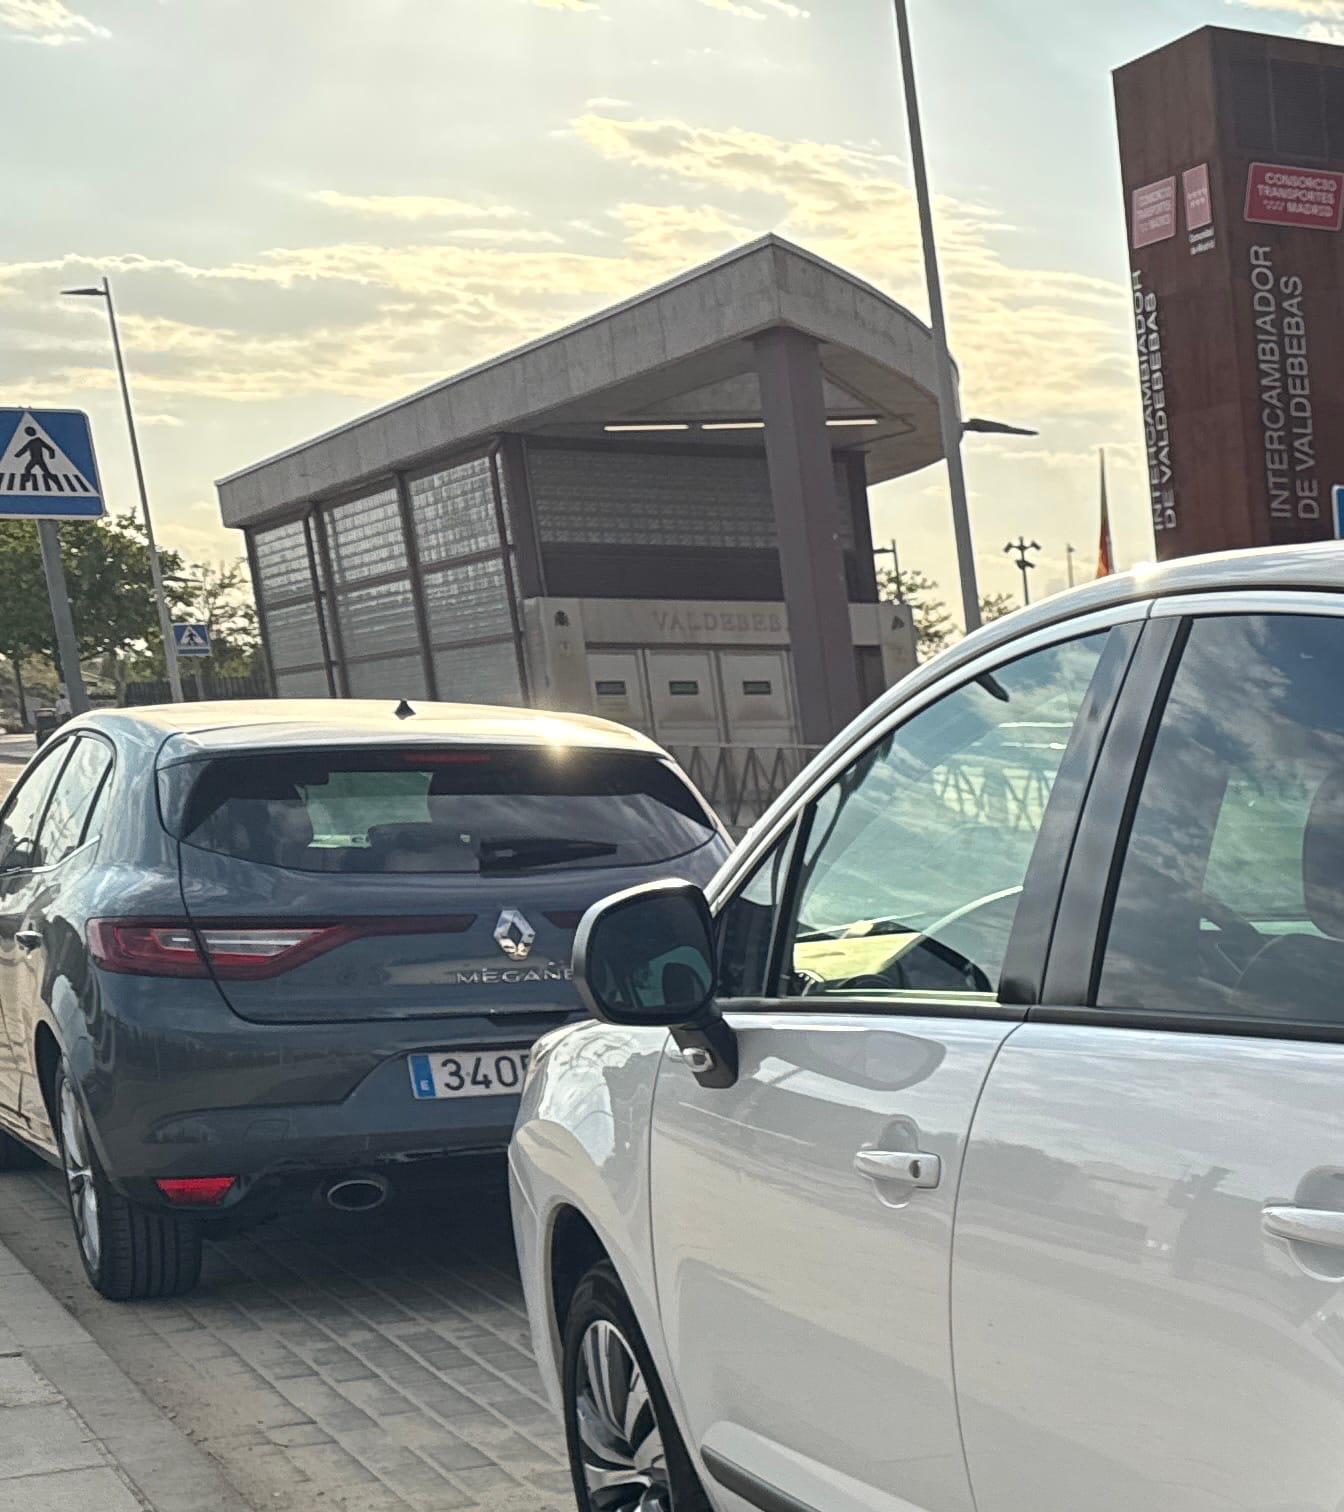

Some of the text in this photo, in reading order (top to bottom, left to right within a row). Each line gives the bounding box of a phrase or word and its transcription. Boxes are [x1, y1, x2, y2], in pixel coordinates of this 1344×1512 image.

[1258, 184, 1336, 204] TRANSPORTES
[1286, 202, 1334, 218] MADRID
[1132, 270, 1165, 530] INTERCAMBIADOR
[1144, 292, 1177, 529] DE VALDEBEBAS
[1250, 246, 1292, 518] INTERCAMBIADOR
[1280, 275, 1321, 519] DE VALDEBEBAS
[653, 610, 789, 632] VALDEBEB
